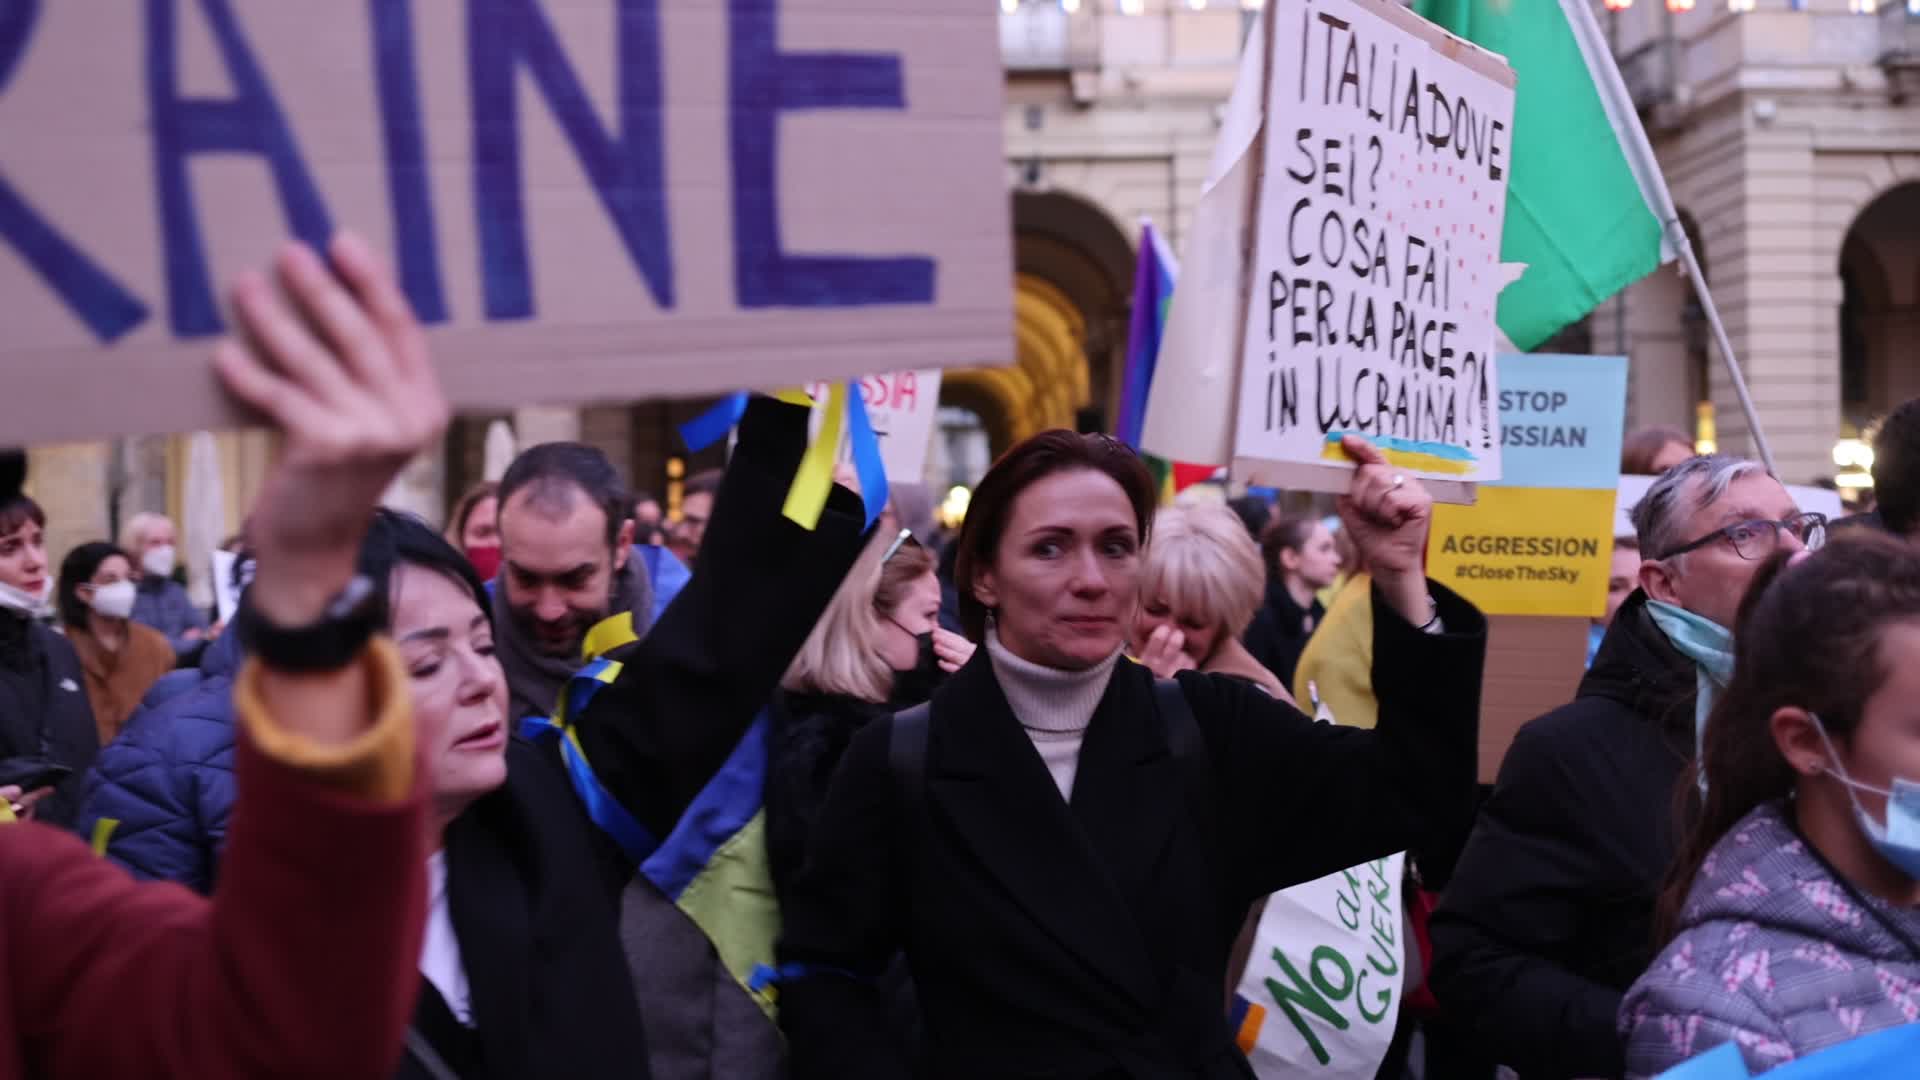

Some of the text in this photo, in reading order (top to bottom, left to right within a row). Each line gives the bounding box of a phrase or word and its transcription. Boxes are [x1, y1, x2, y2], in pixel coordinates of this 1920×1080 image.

[1425, 83, 1504, 181] DOVE
[1287, 197, 1390, 288] COSA
[1267, 270, 1457, 379] PER LA PACE
[1498, 390, 1567, 413] STOP
[1442, 535, 1599, 557] AGGRESSION
[1455, 564, 1579, 584] #CloseTheSky
